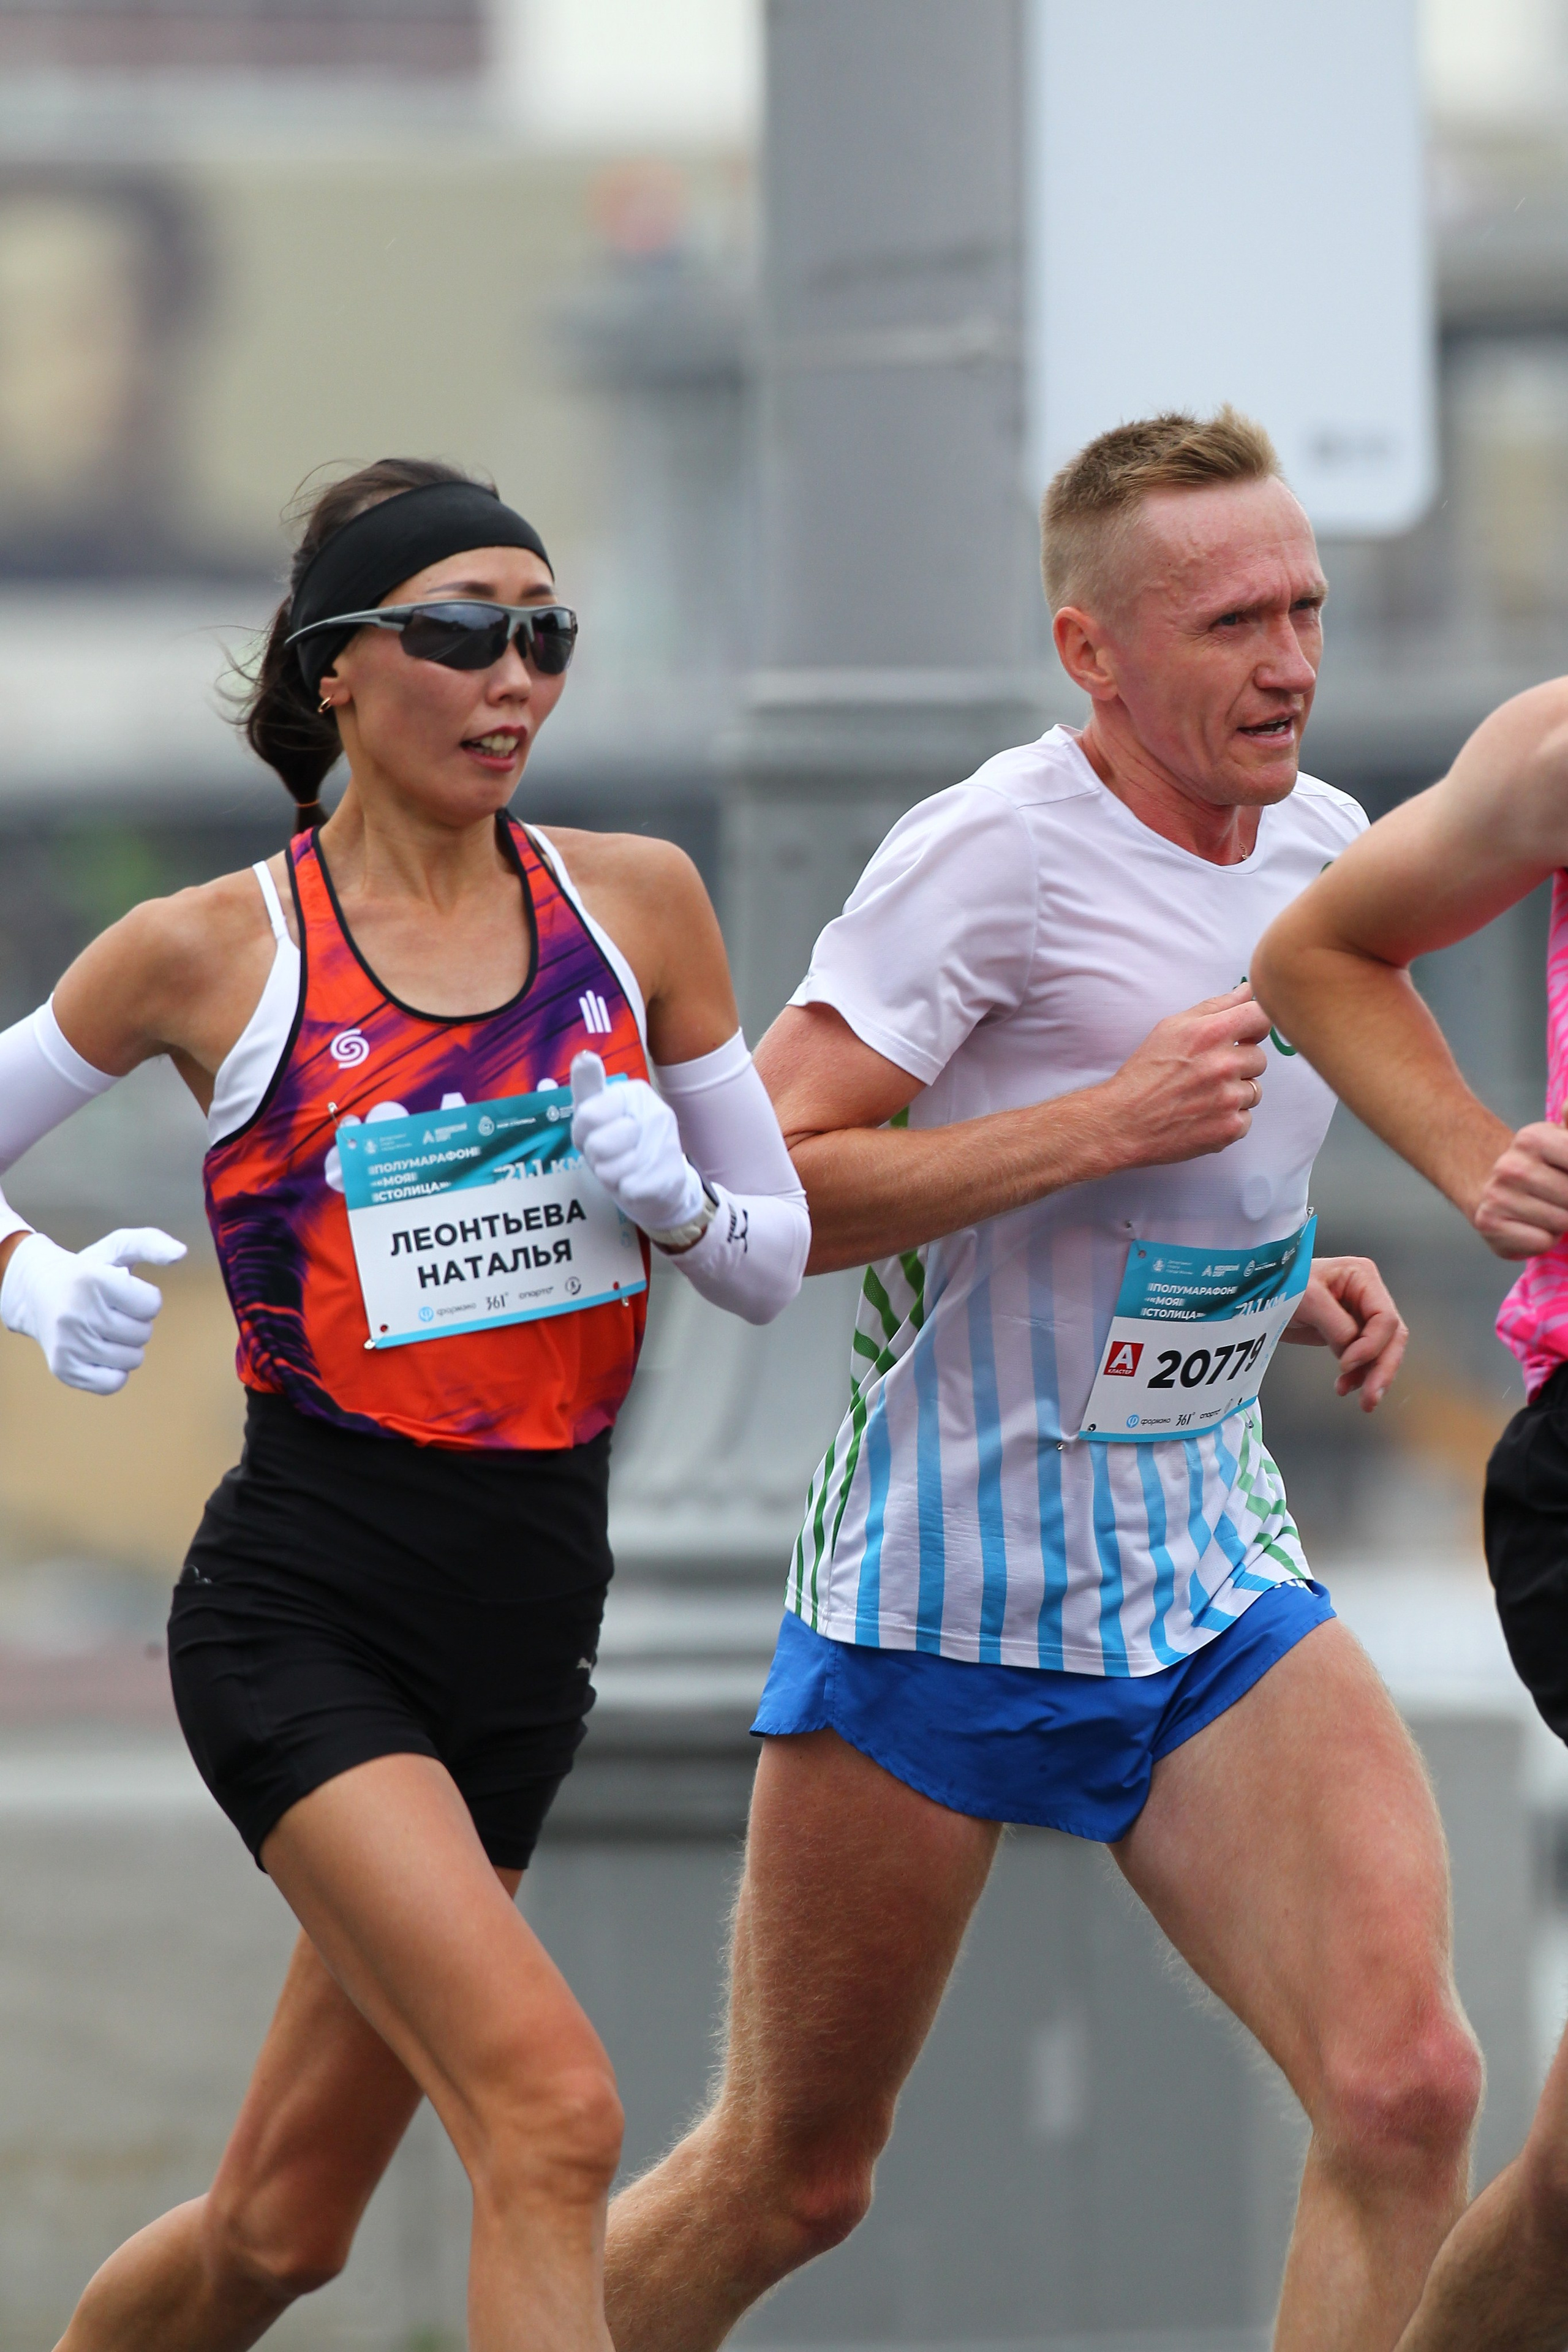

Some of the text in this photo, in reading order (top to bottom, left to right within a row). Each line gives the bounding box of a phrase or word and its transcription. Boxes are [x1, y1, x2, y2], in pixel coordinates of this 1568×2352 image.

[390, 1199, 586, 1256] ЛЕОНТЬЕВА
[418, 1238, 573, 1289] НАТАЛЬЯ
[1147, 1332, 1267, 1389] 20779
